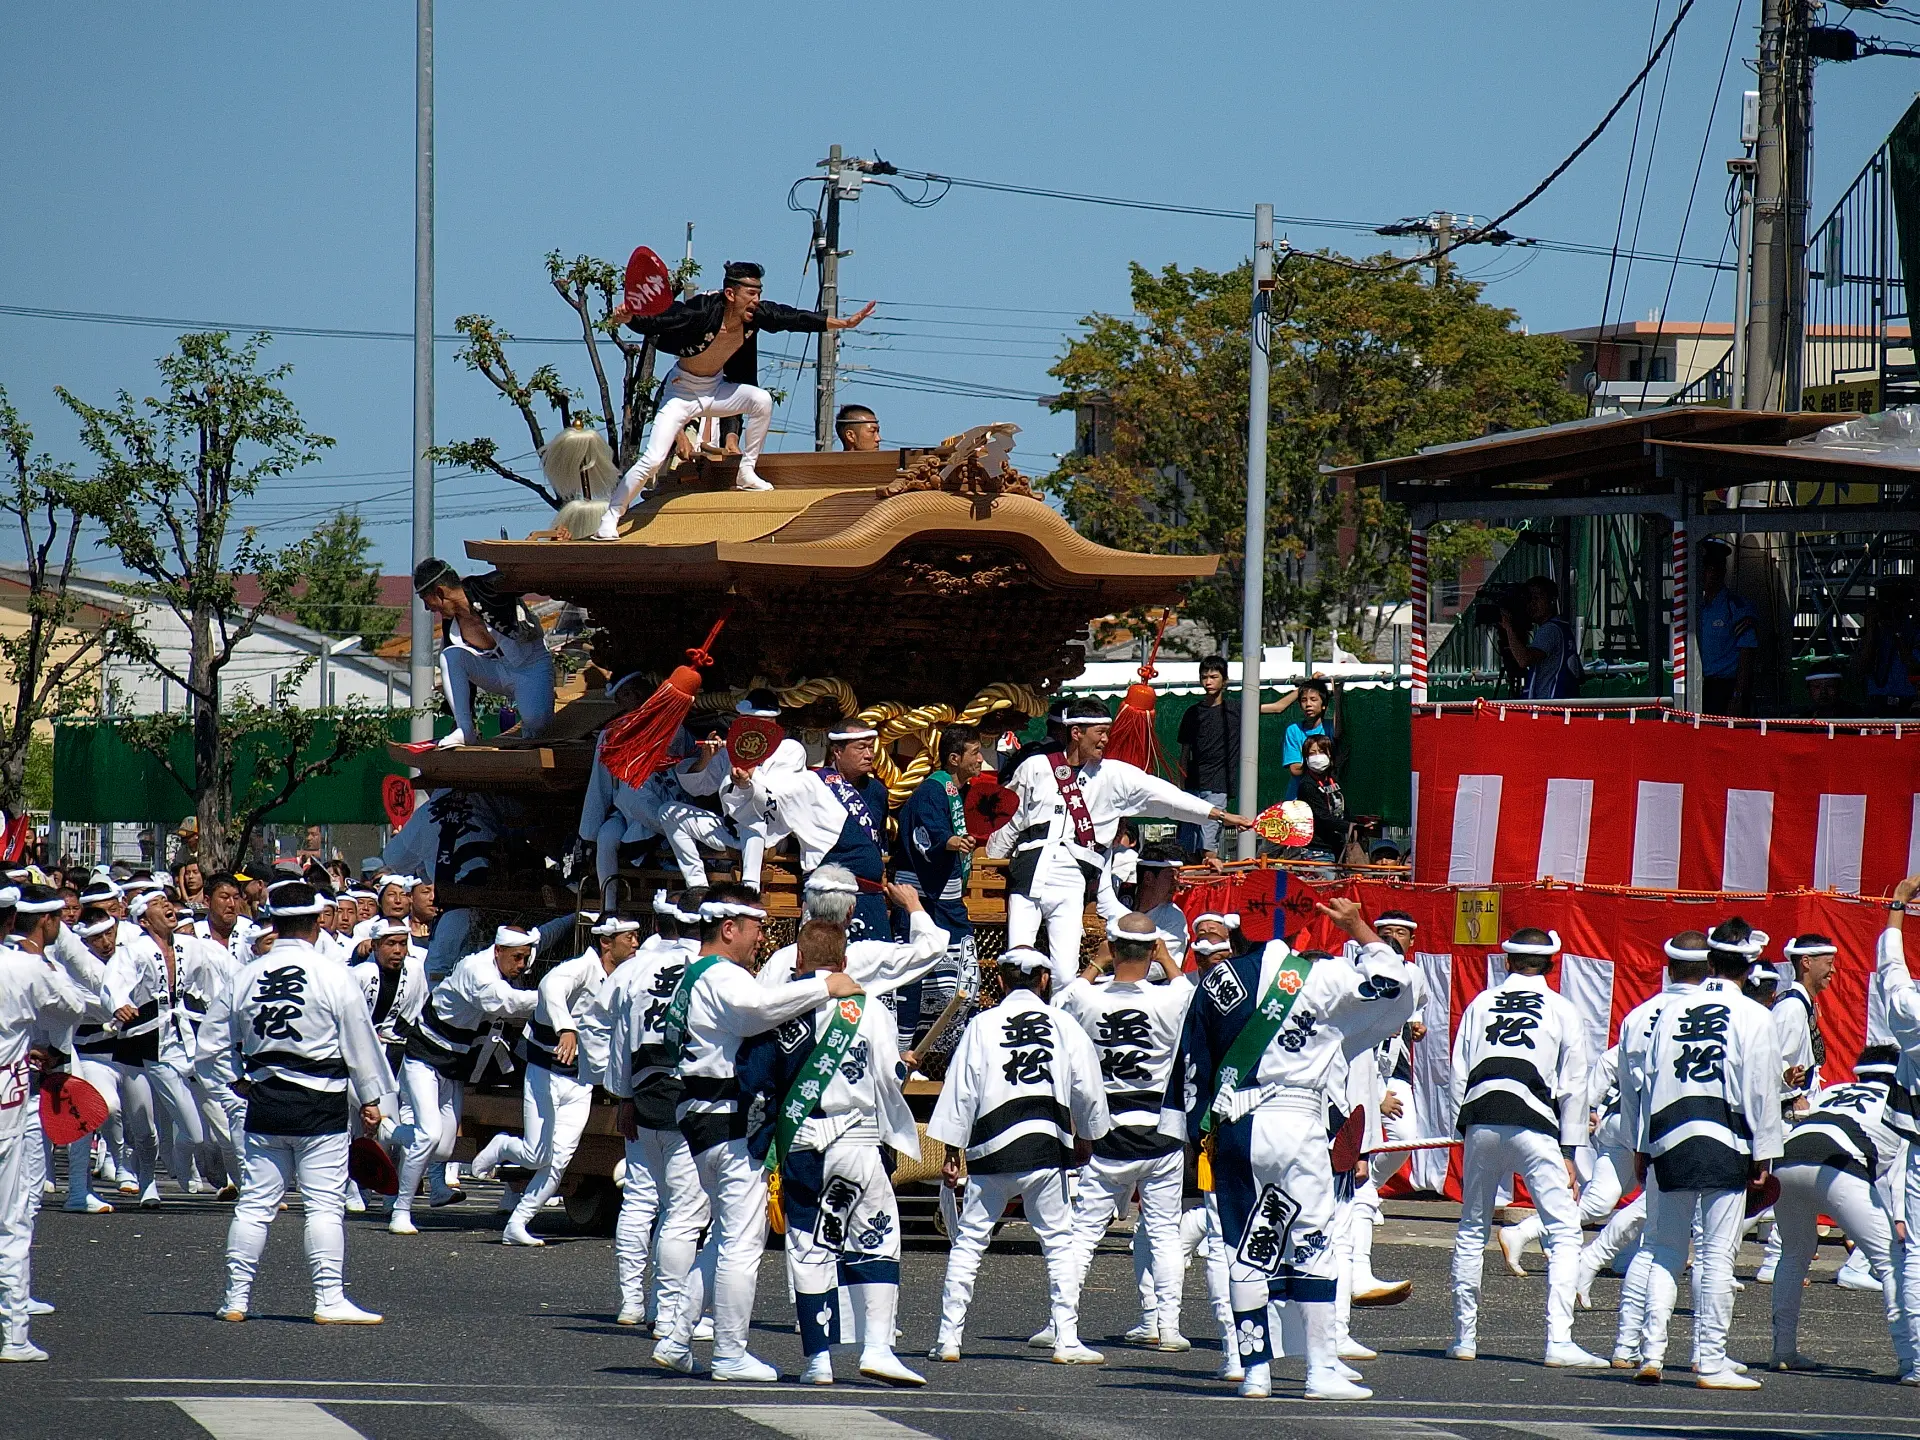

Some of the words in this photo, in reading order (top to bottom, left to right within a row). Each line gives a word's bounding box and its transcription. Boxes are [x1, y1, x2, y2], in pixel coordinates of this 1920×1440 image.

[1461, 900, 1494, 912] 立入禁止
[785, 1028, 850, 1125] 副年番長
